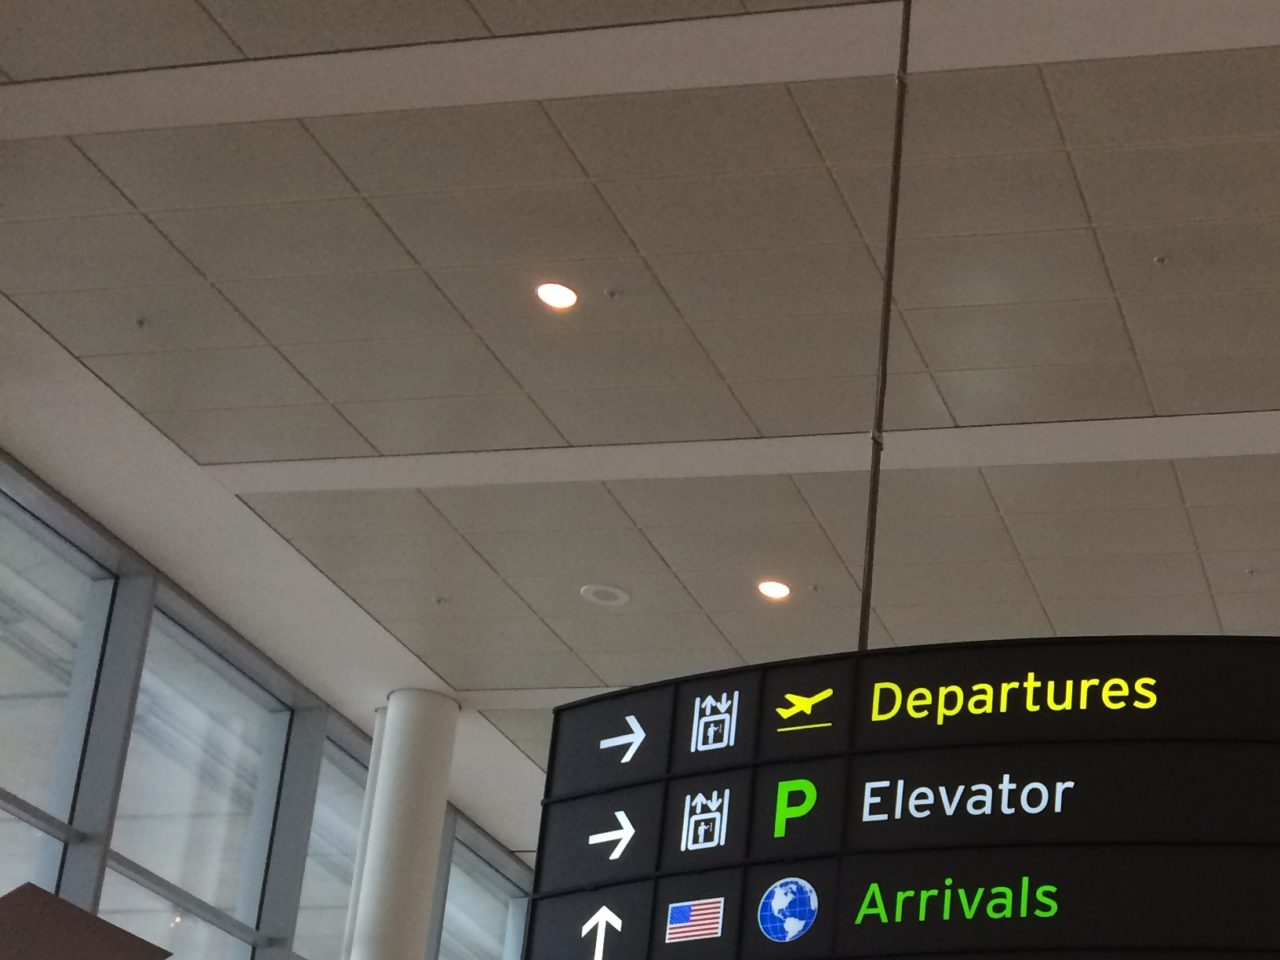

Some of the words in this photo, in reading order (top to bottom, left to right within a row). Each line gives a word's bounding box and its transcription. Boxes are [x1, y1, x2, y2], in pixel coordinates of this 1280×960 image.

[872, 672, 1157, 725] Departures
[774, 779, 817, 837] P
[863, 774, 1075, 822] Elevator
[855, 877, 1058, 924] Arrivals
